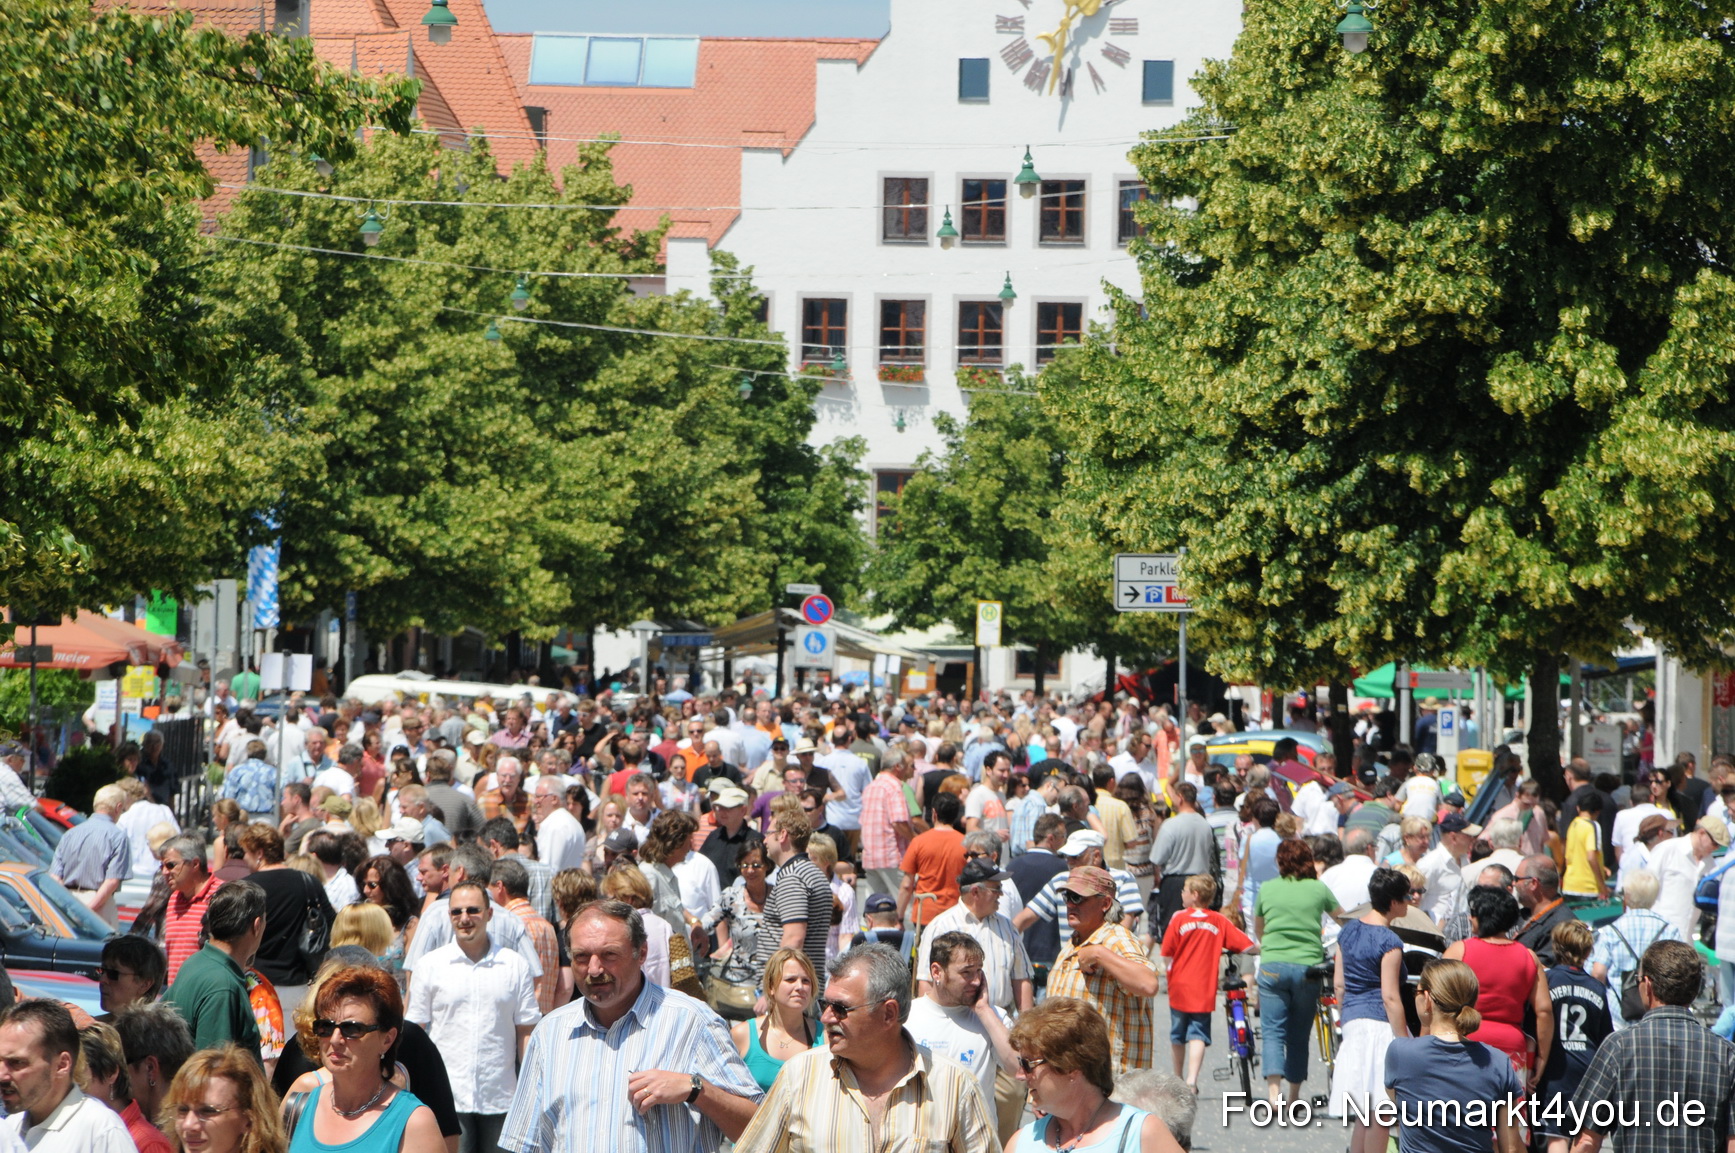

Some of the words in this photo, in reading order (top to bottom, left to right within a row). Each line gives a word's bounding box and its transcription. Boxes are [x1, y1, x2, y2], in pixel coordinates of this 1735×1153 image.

[1140, 561, 1178, 575] Parkle
[1549, 985, 1573, 1001] AYERN
[1559, 1003, 1587, 1041] 12
